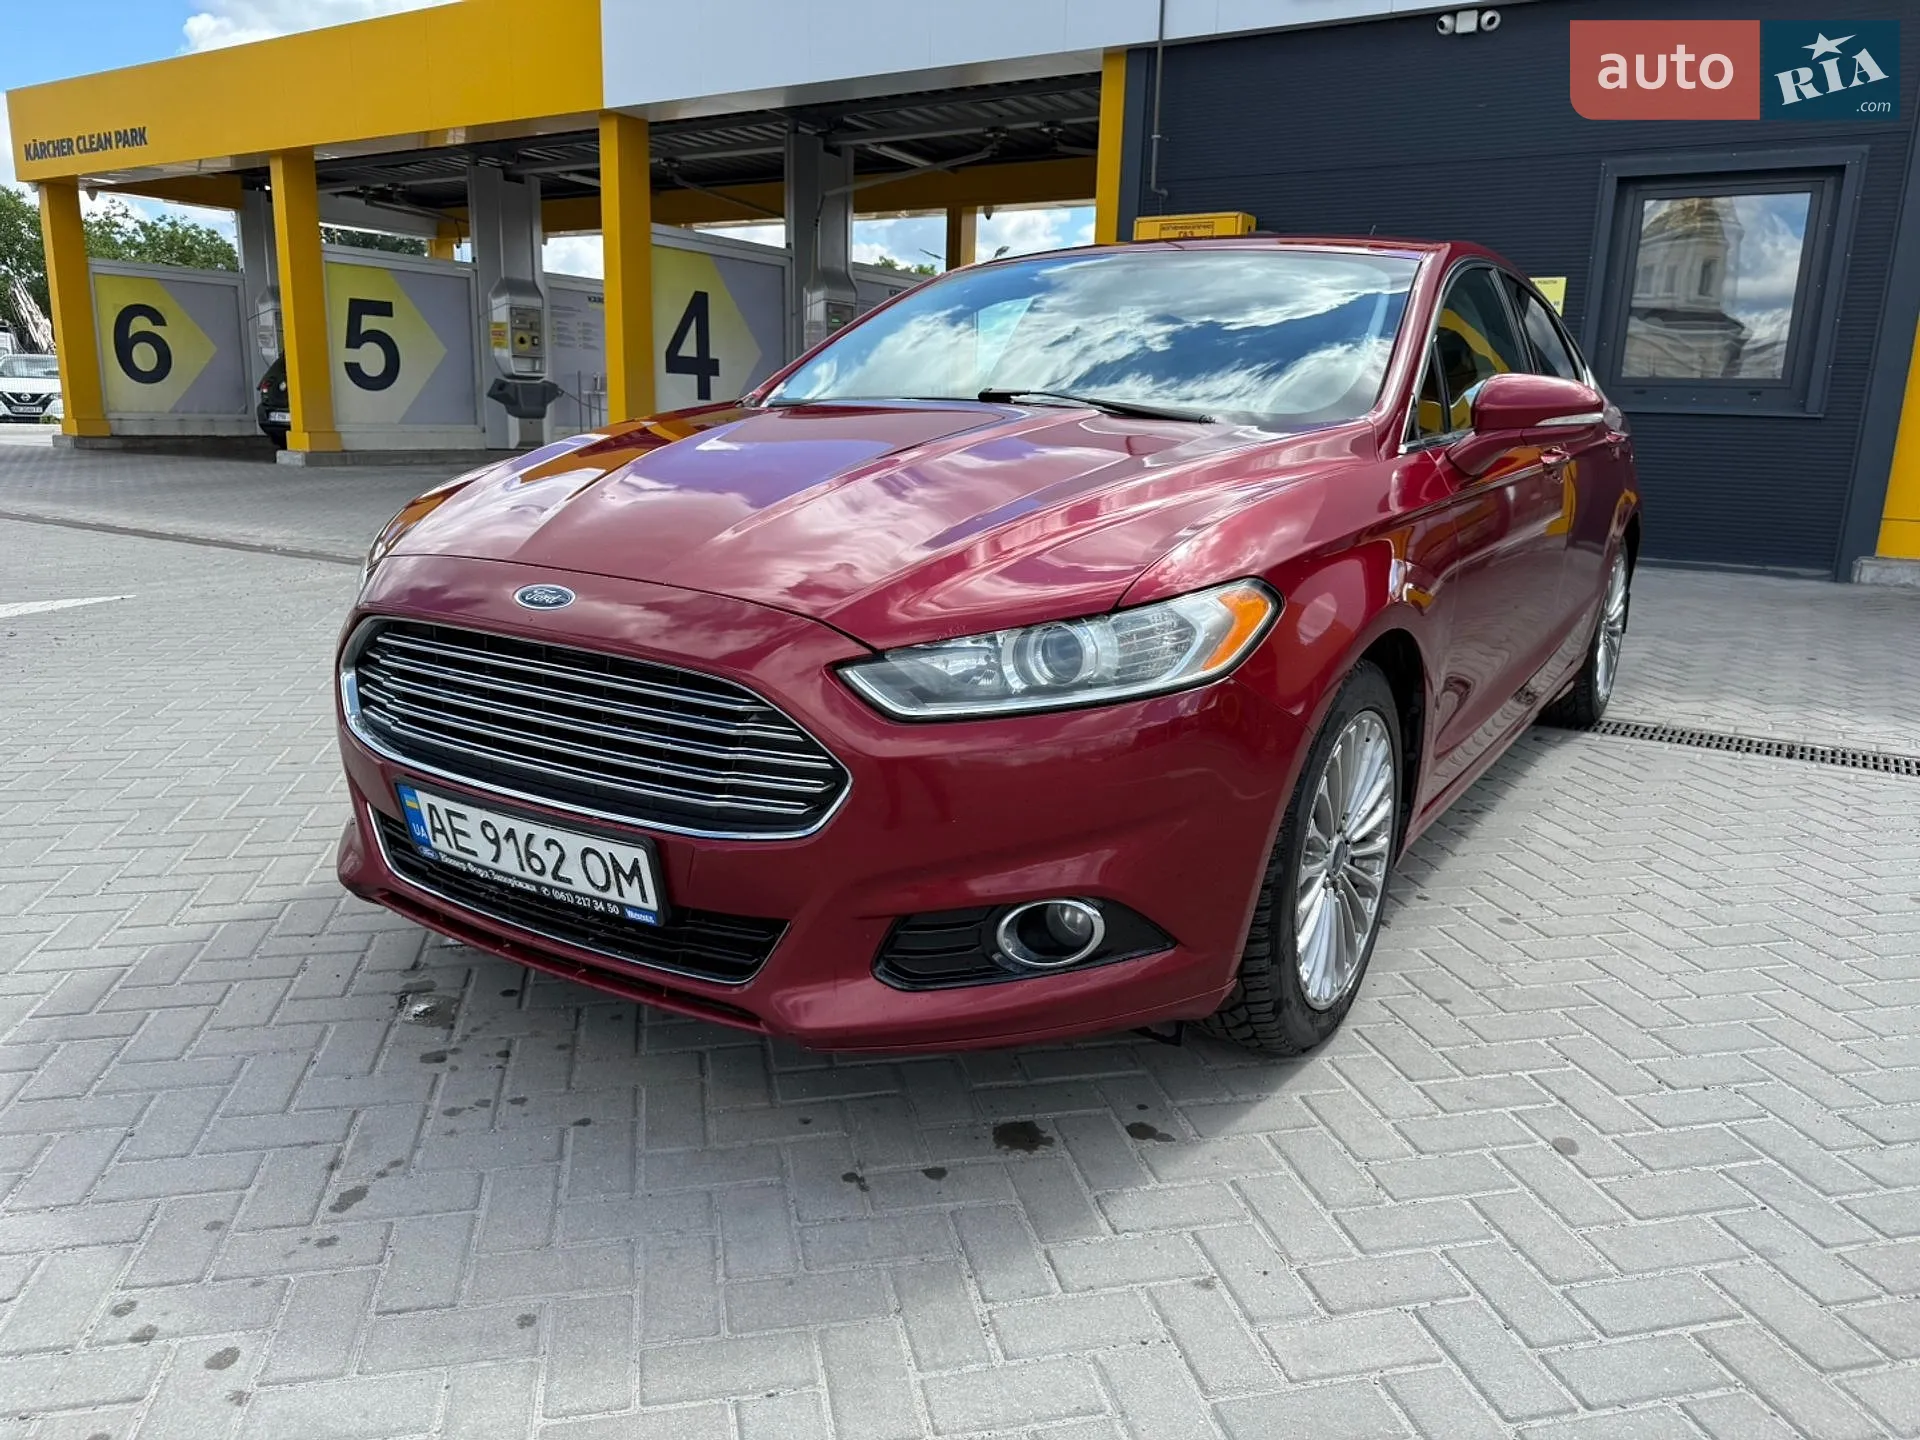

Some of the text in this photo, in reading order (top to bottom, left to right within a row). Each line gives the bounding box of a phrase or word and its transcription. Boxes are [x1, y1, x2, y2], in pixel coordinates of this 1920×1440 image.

[24, 126, 148, 161] KÄRCHER CLEAN PARK
[113, 303, 173, 385] 6
[344, 298, 401, 391] 5
[665, 290, 720, 401] 4
[525, 588, 562, 604] Ford
[412, 823, 428, 839] UA
[427, 803, 478, 857] AE
[480, 820, 573, 885] 9162
[580, 847, 649, 904] OM
